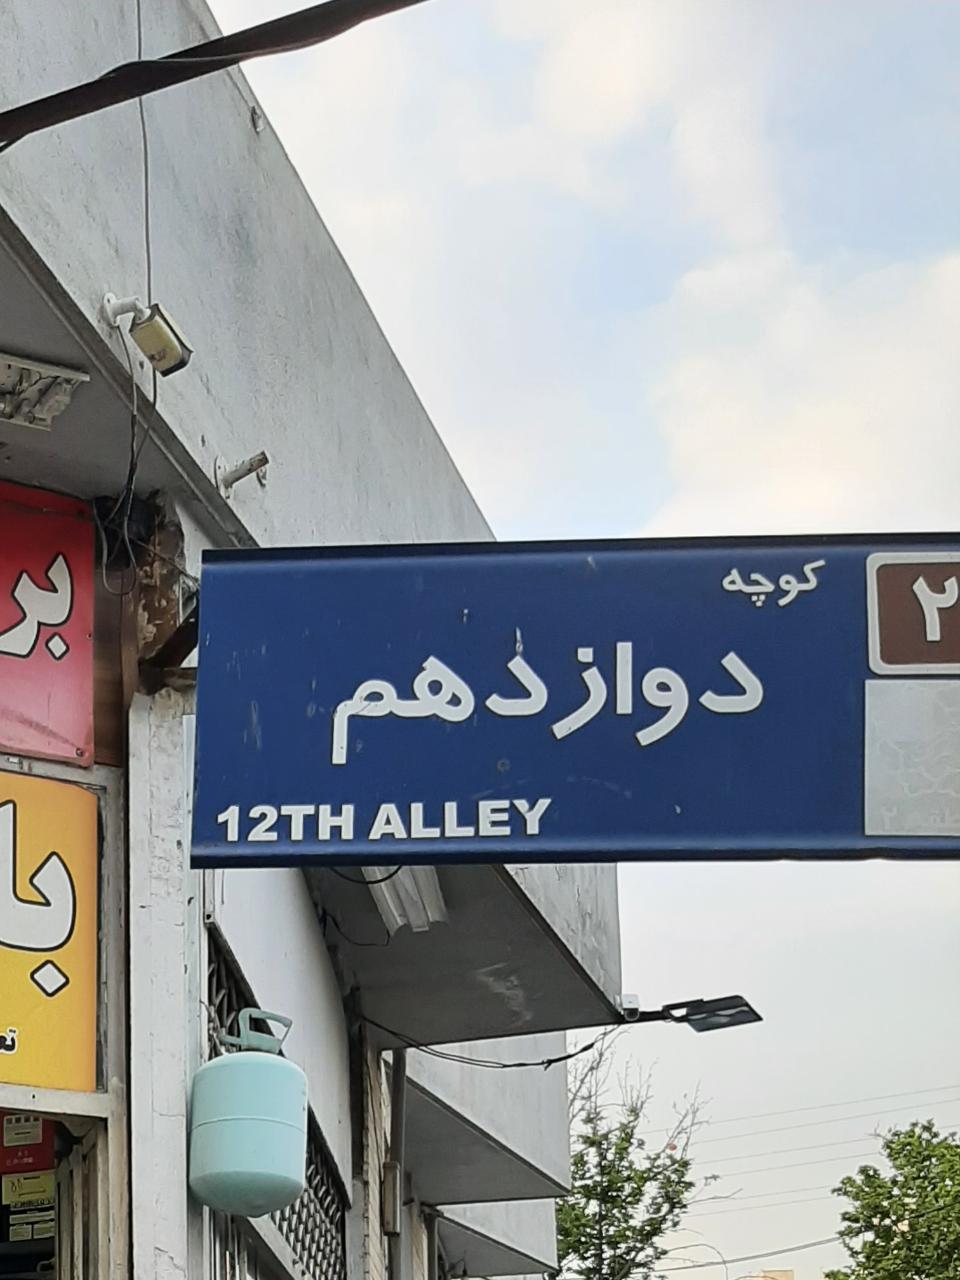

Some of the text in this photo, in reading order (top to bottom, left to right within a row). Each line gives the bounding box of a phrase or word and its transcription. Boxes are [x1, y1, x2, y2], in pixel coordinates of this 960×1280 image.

[722, 560, 826, 606] کوچه
[331, 641, 764, 765] دوازدهم
[216, 798, 553, 842] 12TH ALLEY
